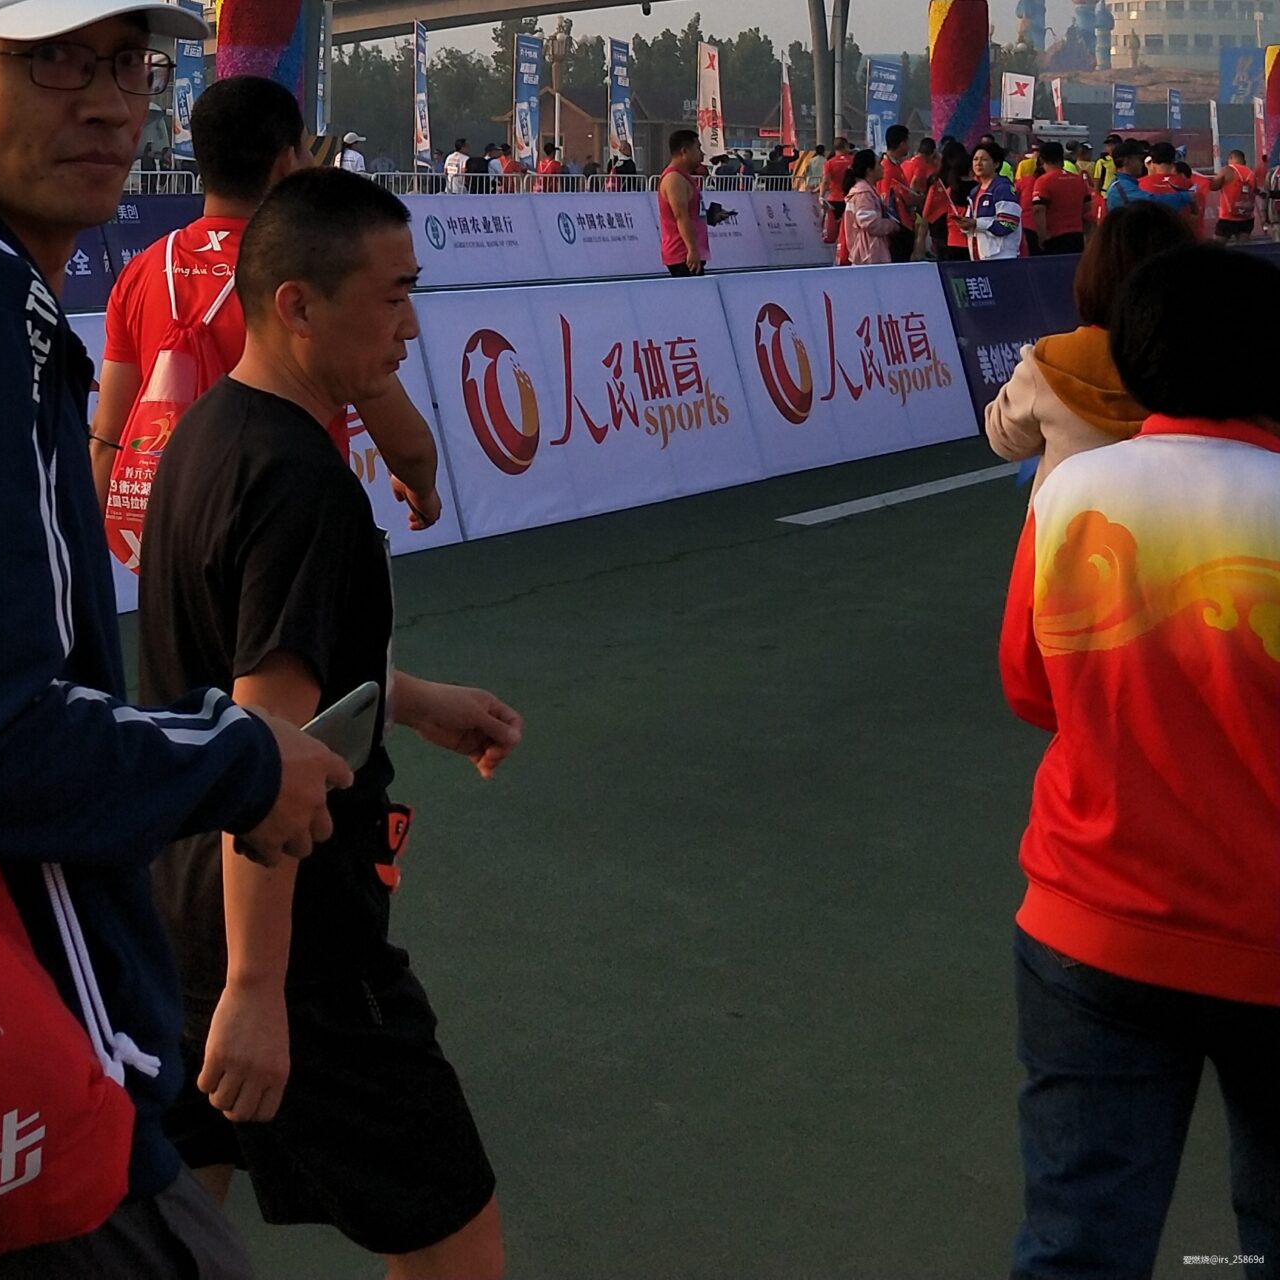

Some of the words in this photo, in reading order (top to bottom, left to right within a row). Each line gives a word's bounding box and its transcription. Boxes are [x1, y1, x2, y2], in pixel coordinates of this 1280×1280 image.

[446, 215, 514, 235] 中国农业银行
[576, 212, 634, 231] 中国农业银行
[966, 276, 993, 300] 美创
[820, 290, 932, 401] 人民体育
[549, 313, 704, 446] 人民体育
[887, 346, 952, 407] sports
[644, 376, 730, 451] sports
